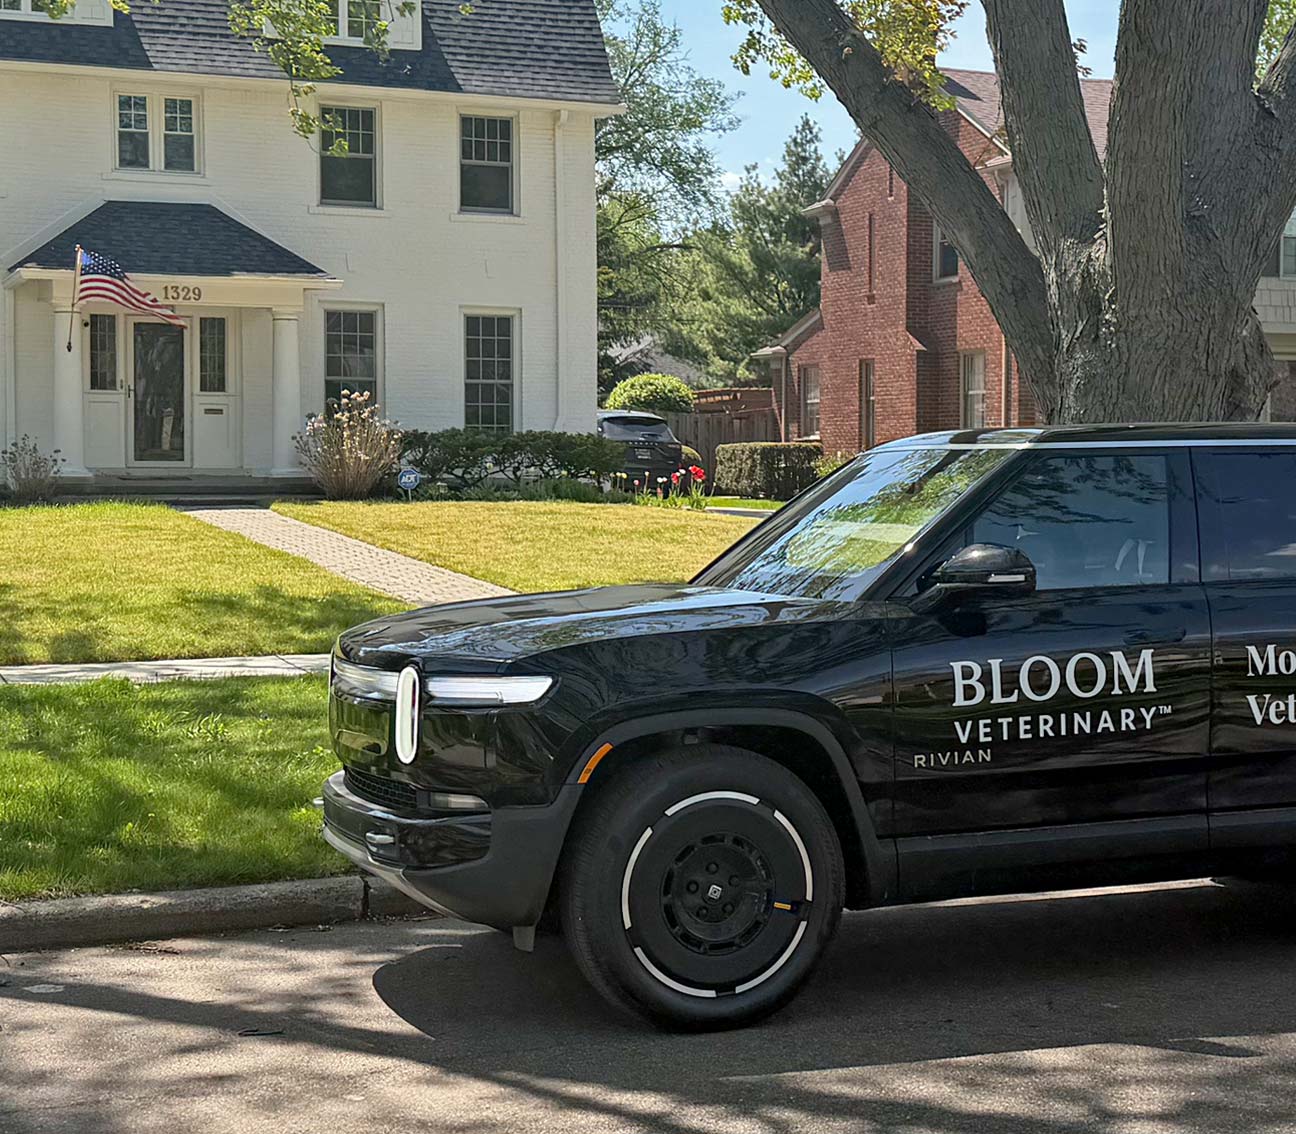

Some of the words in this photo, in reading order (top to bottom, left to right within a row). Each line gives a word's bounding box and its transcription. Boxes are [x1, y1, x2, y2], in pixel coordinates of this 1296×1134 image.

[162, 285, 202, 301] 1329
[950, 648, 1157, 706] BLOOM
[914, 749, 992, 768] RIVIAN
